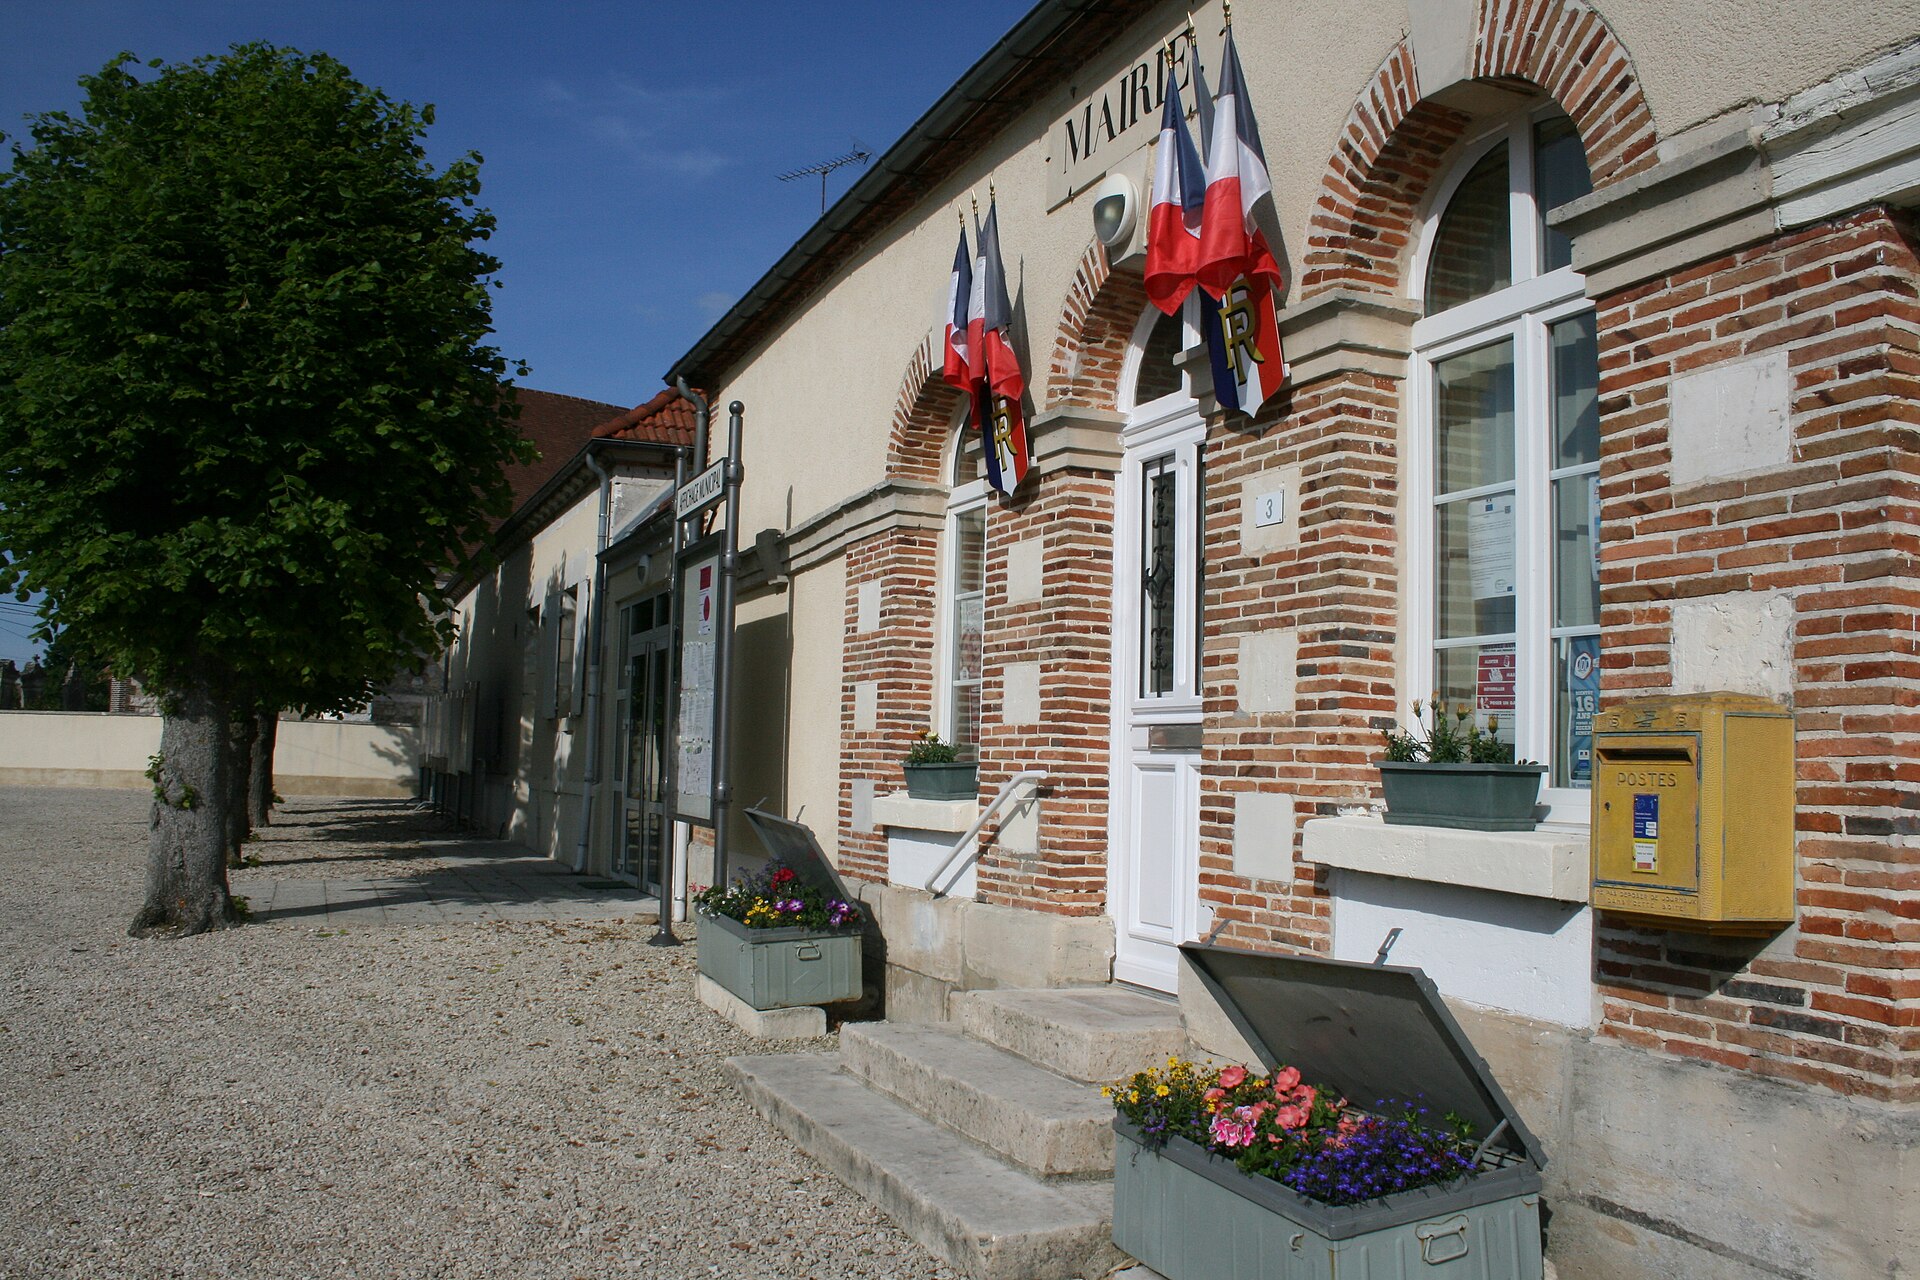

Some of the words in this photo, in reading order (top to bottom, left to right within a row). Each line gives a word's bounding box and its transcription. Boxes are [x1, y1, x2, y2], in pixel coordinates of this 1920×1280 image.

[1063, 28, 1190, 175] MAIRIE
[1265, 498, 1273, 519] 3
[1575, 696, 1595, 712] 16
[1617, 772, 1677, 787] POSTES
